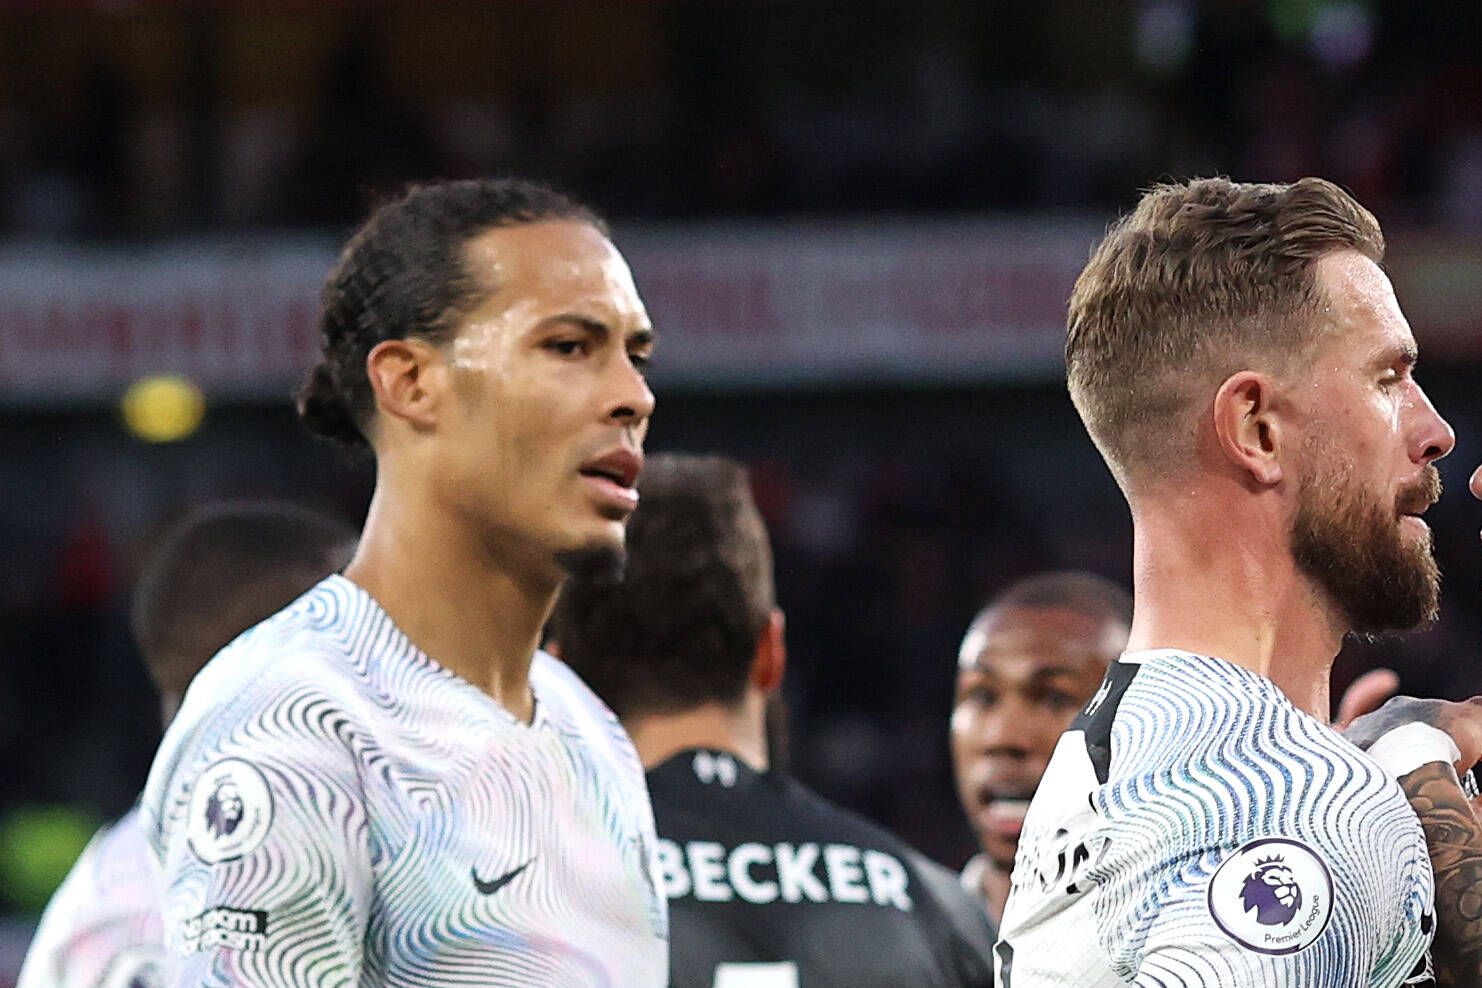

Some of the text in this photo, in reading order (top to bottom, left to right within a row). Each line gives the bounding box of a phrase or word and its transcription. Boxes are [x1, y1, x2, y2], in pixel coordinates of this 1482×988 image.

[656, 838, 912, 912] BECKER
[1264, 894, 1321, 944] Premier League
